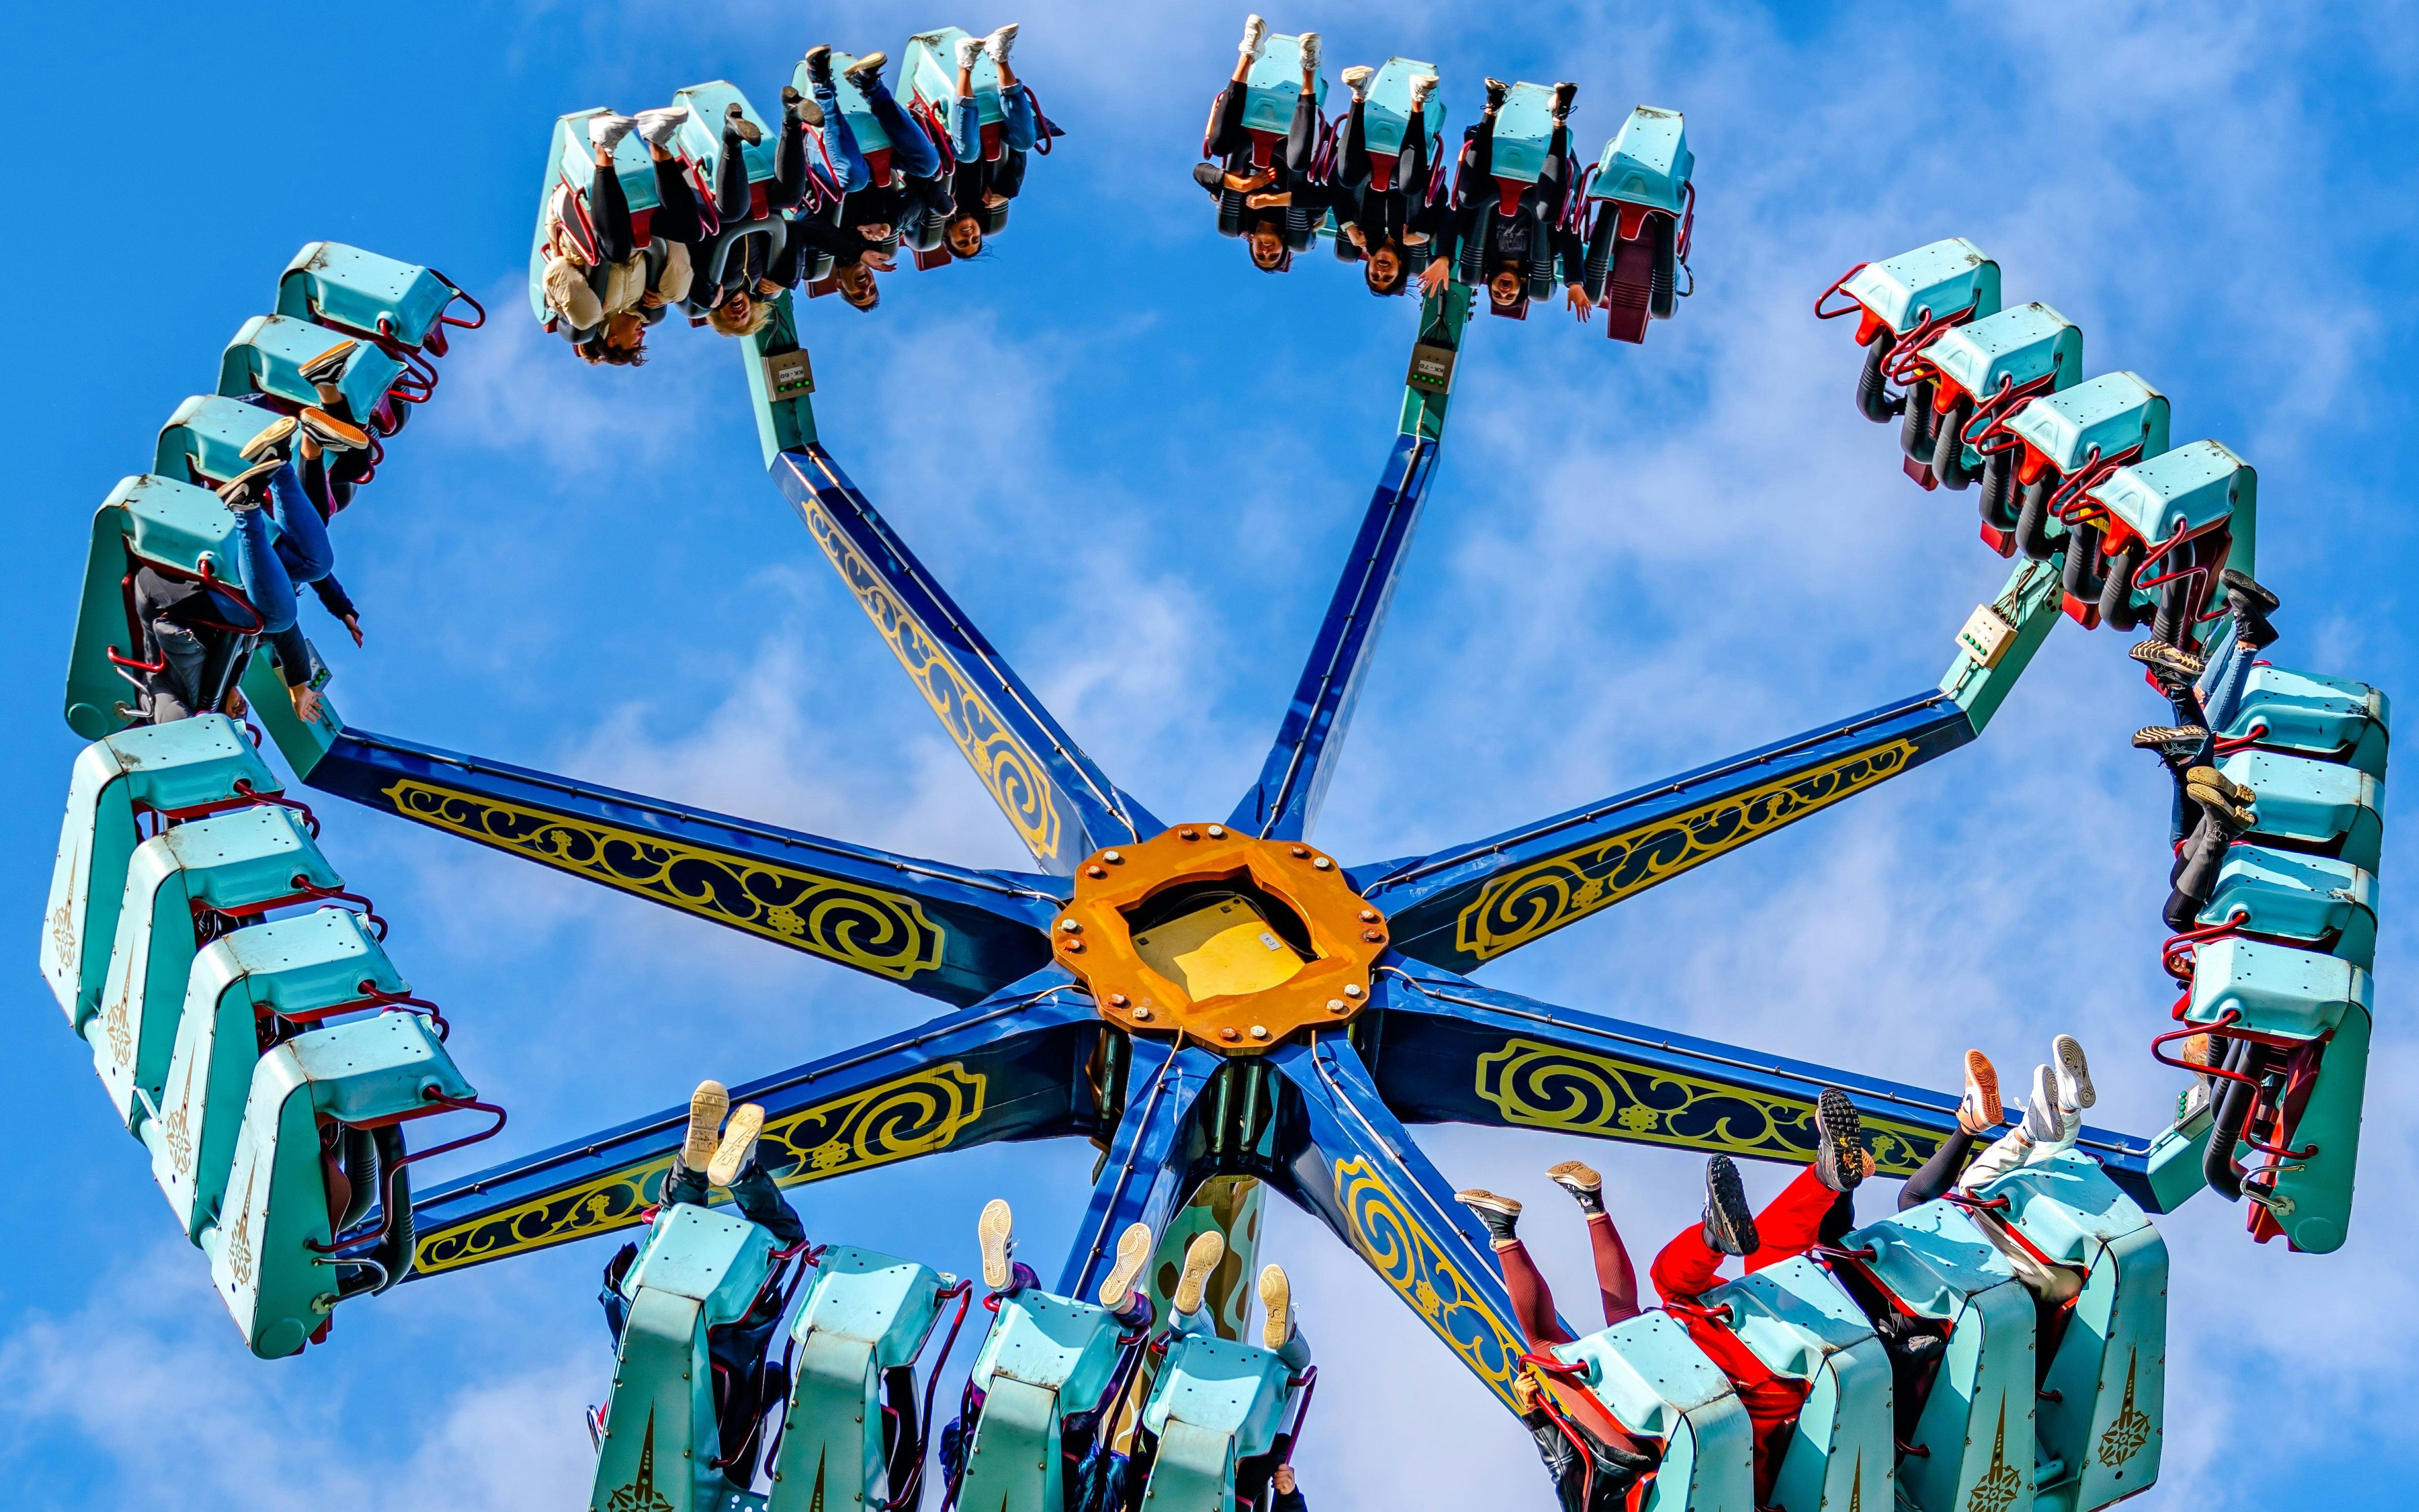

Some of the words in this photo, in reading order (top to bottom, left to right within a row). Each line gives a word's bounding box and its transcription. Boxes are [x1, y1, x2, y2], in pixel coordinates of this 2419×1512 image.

[1420, 364, 1444, 373] KK-70
[780, 370, 804, 379] KK-60
[1264, 937, 1275, 946] K-3
